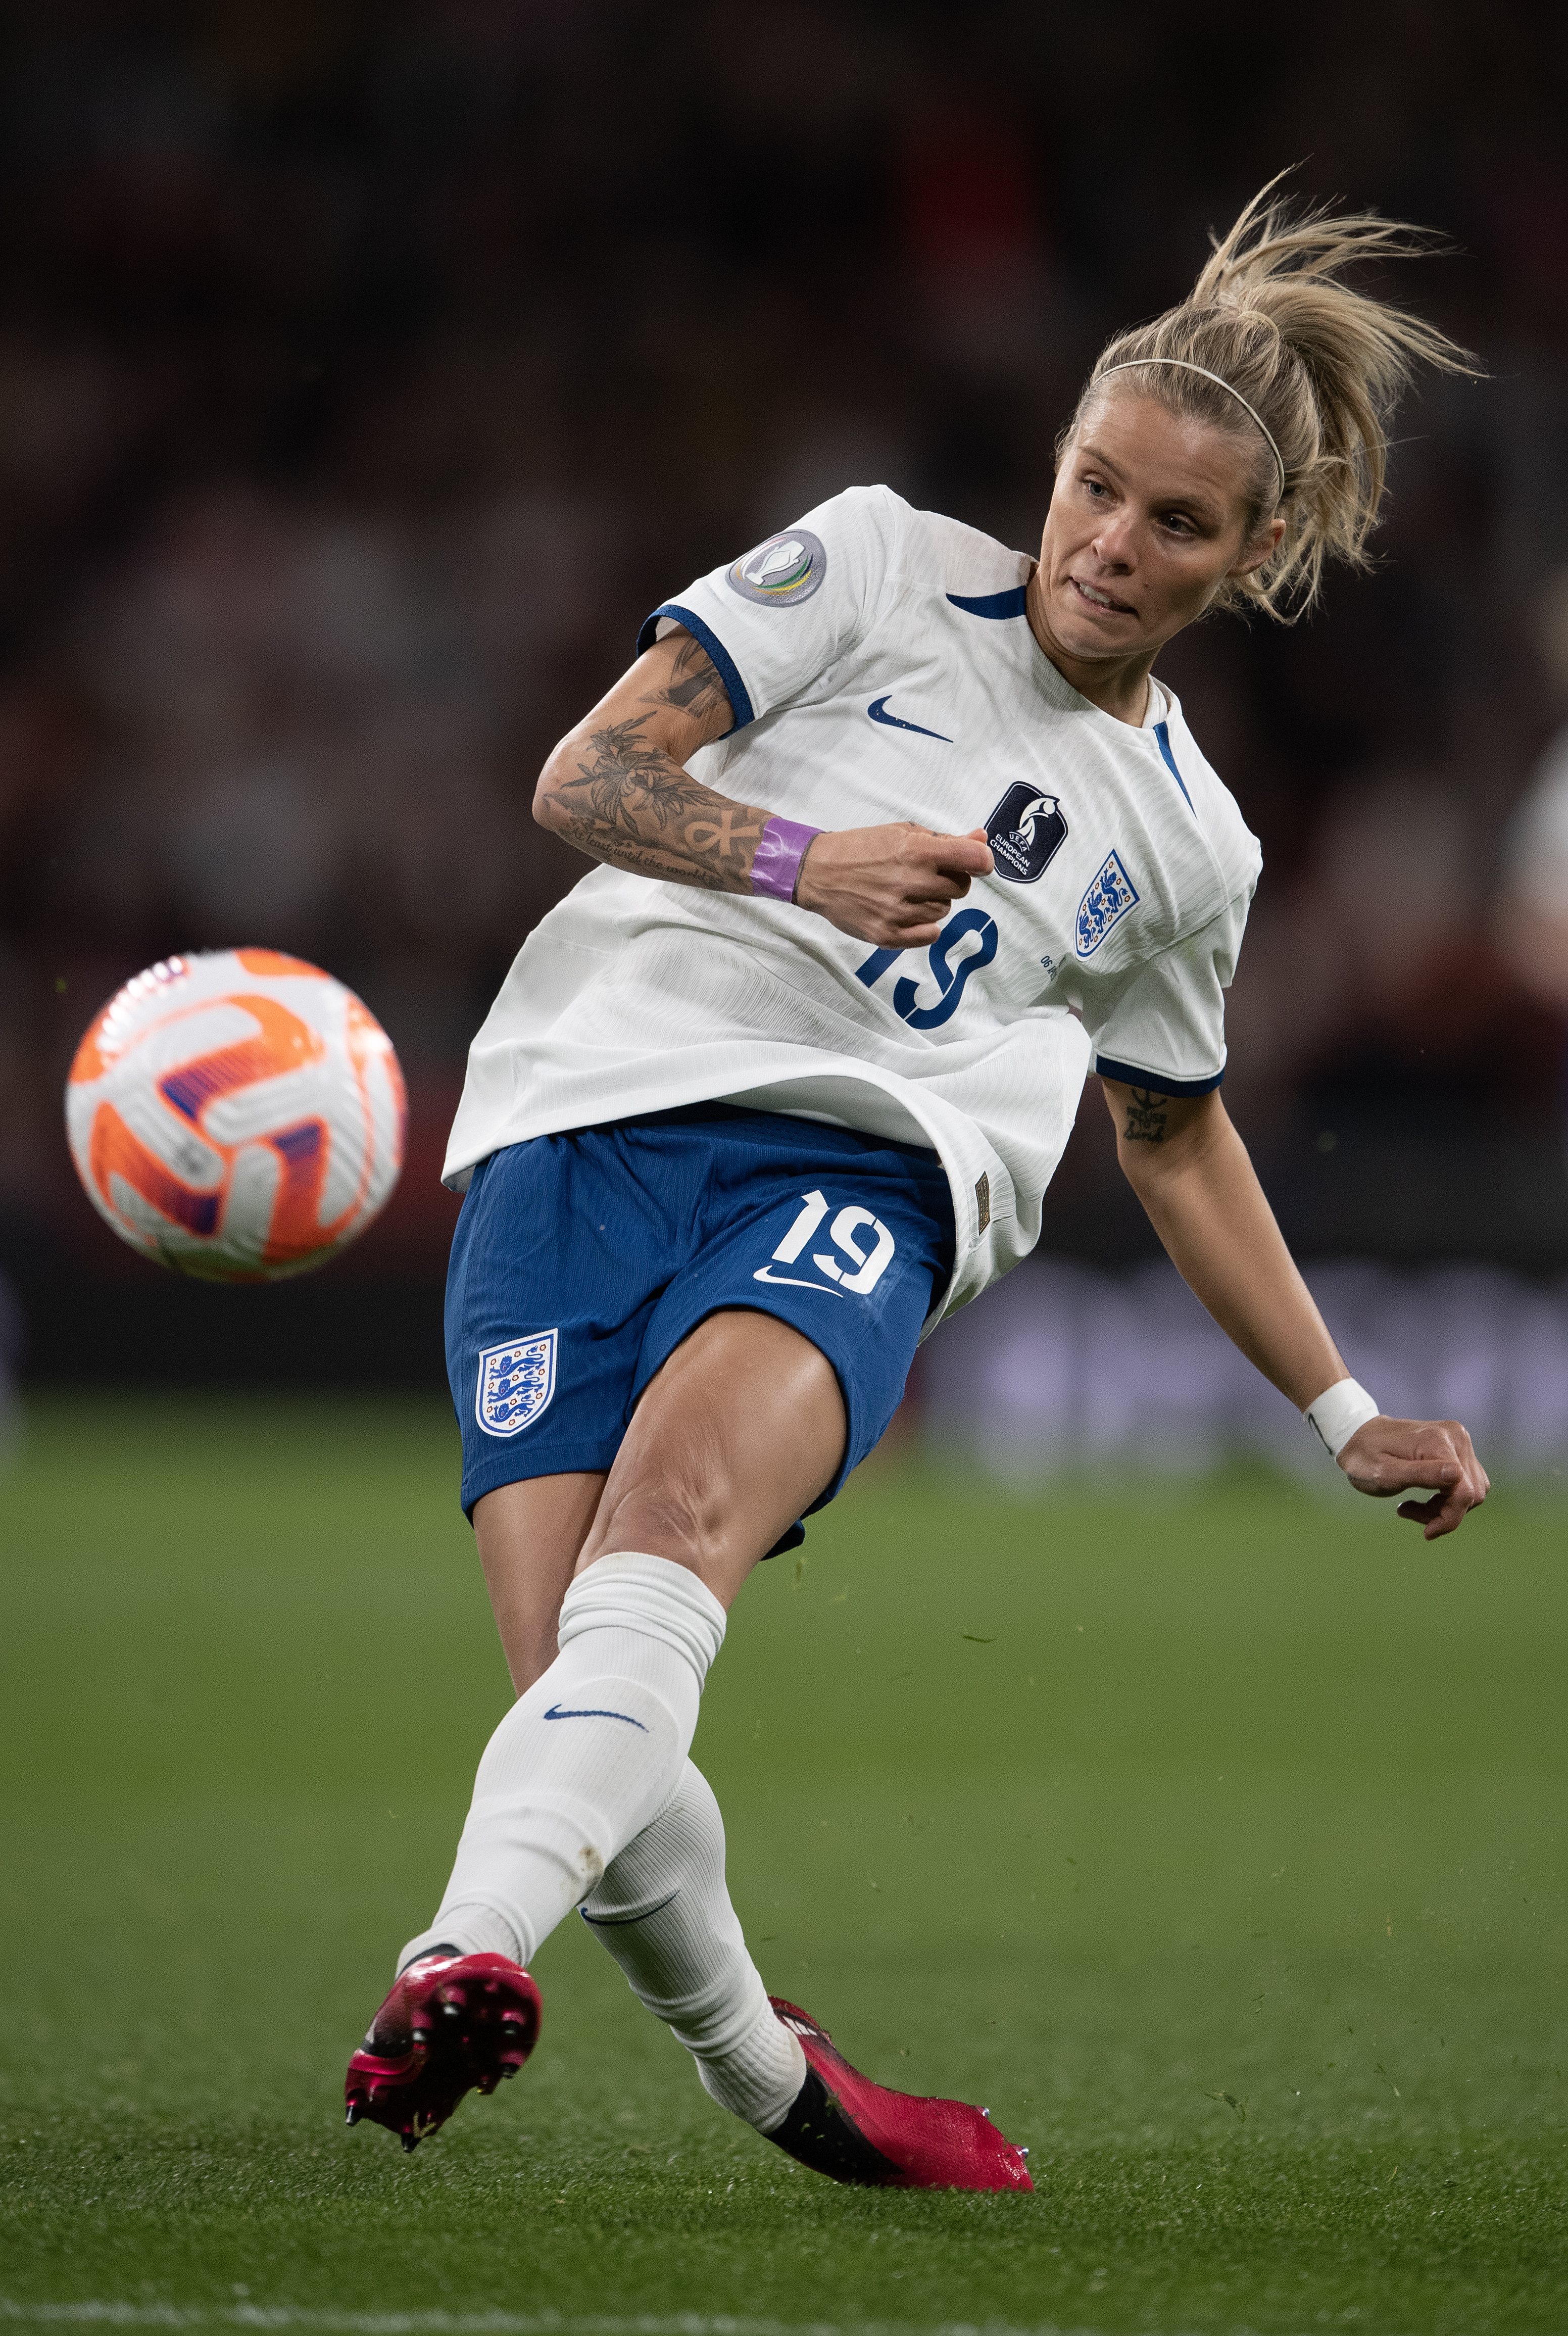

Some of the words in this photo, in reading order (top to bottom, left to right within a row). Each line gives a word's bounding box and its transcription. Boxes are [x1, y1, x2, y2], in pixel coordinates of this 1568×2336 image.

[586, 834, 613, 852] least
[613, 849, 643, 863] until
[644, 855, 663, 869] the
[666, 865, 707, 880] world
[990, 839, 1027, 875] CHAMPIONS
[995, 834, 1030, 867] EUROPEAN
[1009, 834, 1027, 852] UEFA
[1041, 955, 1053, 967] 06
[771, 1190, 895, 1294] 19
